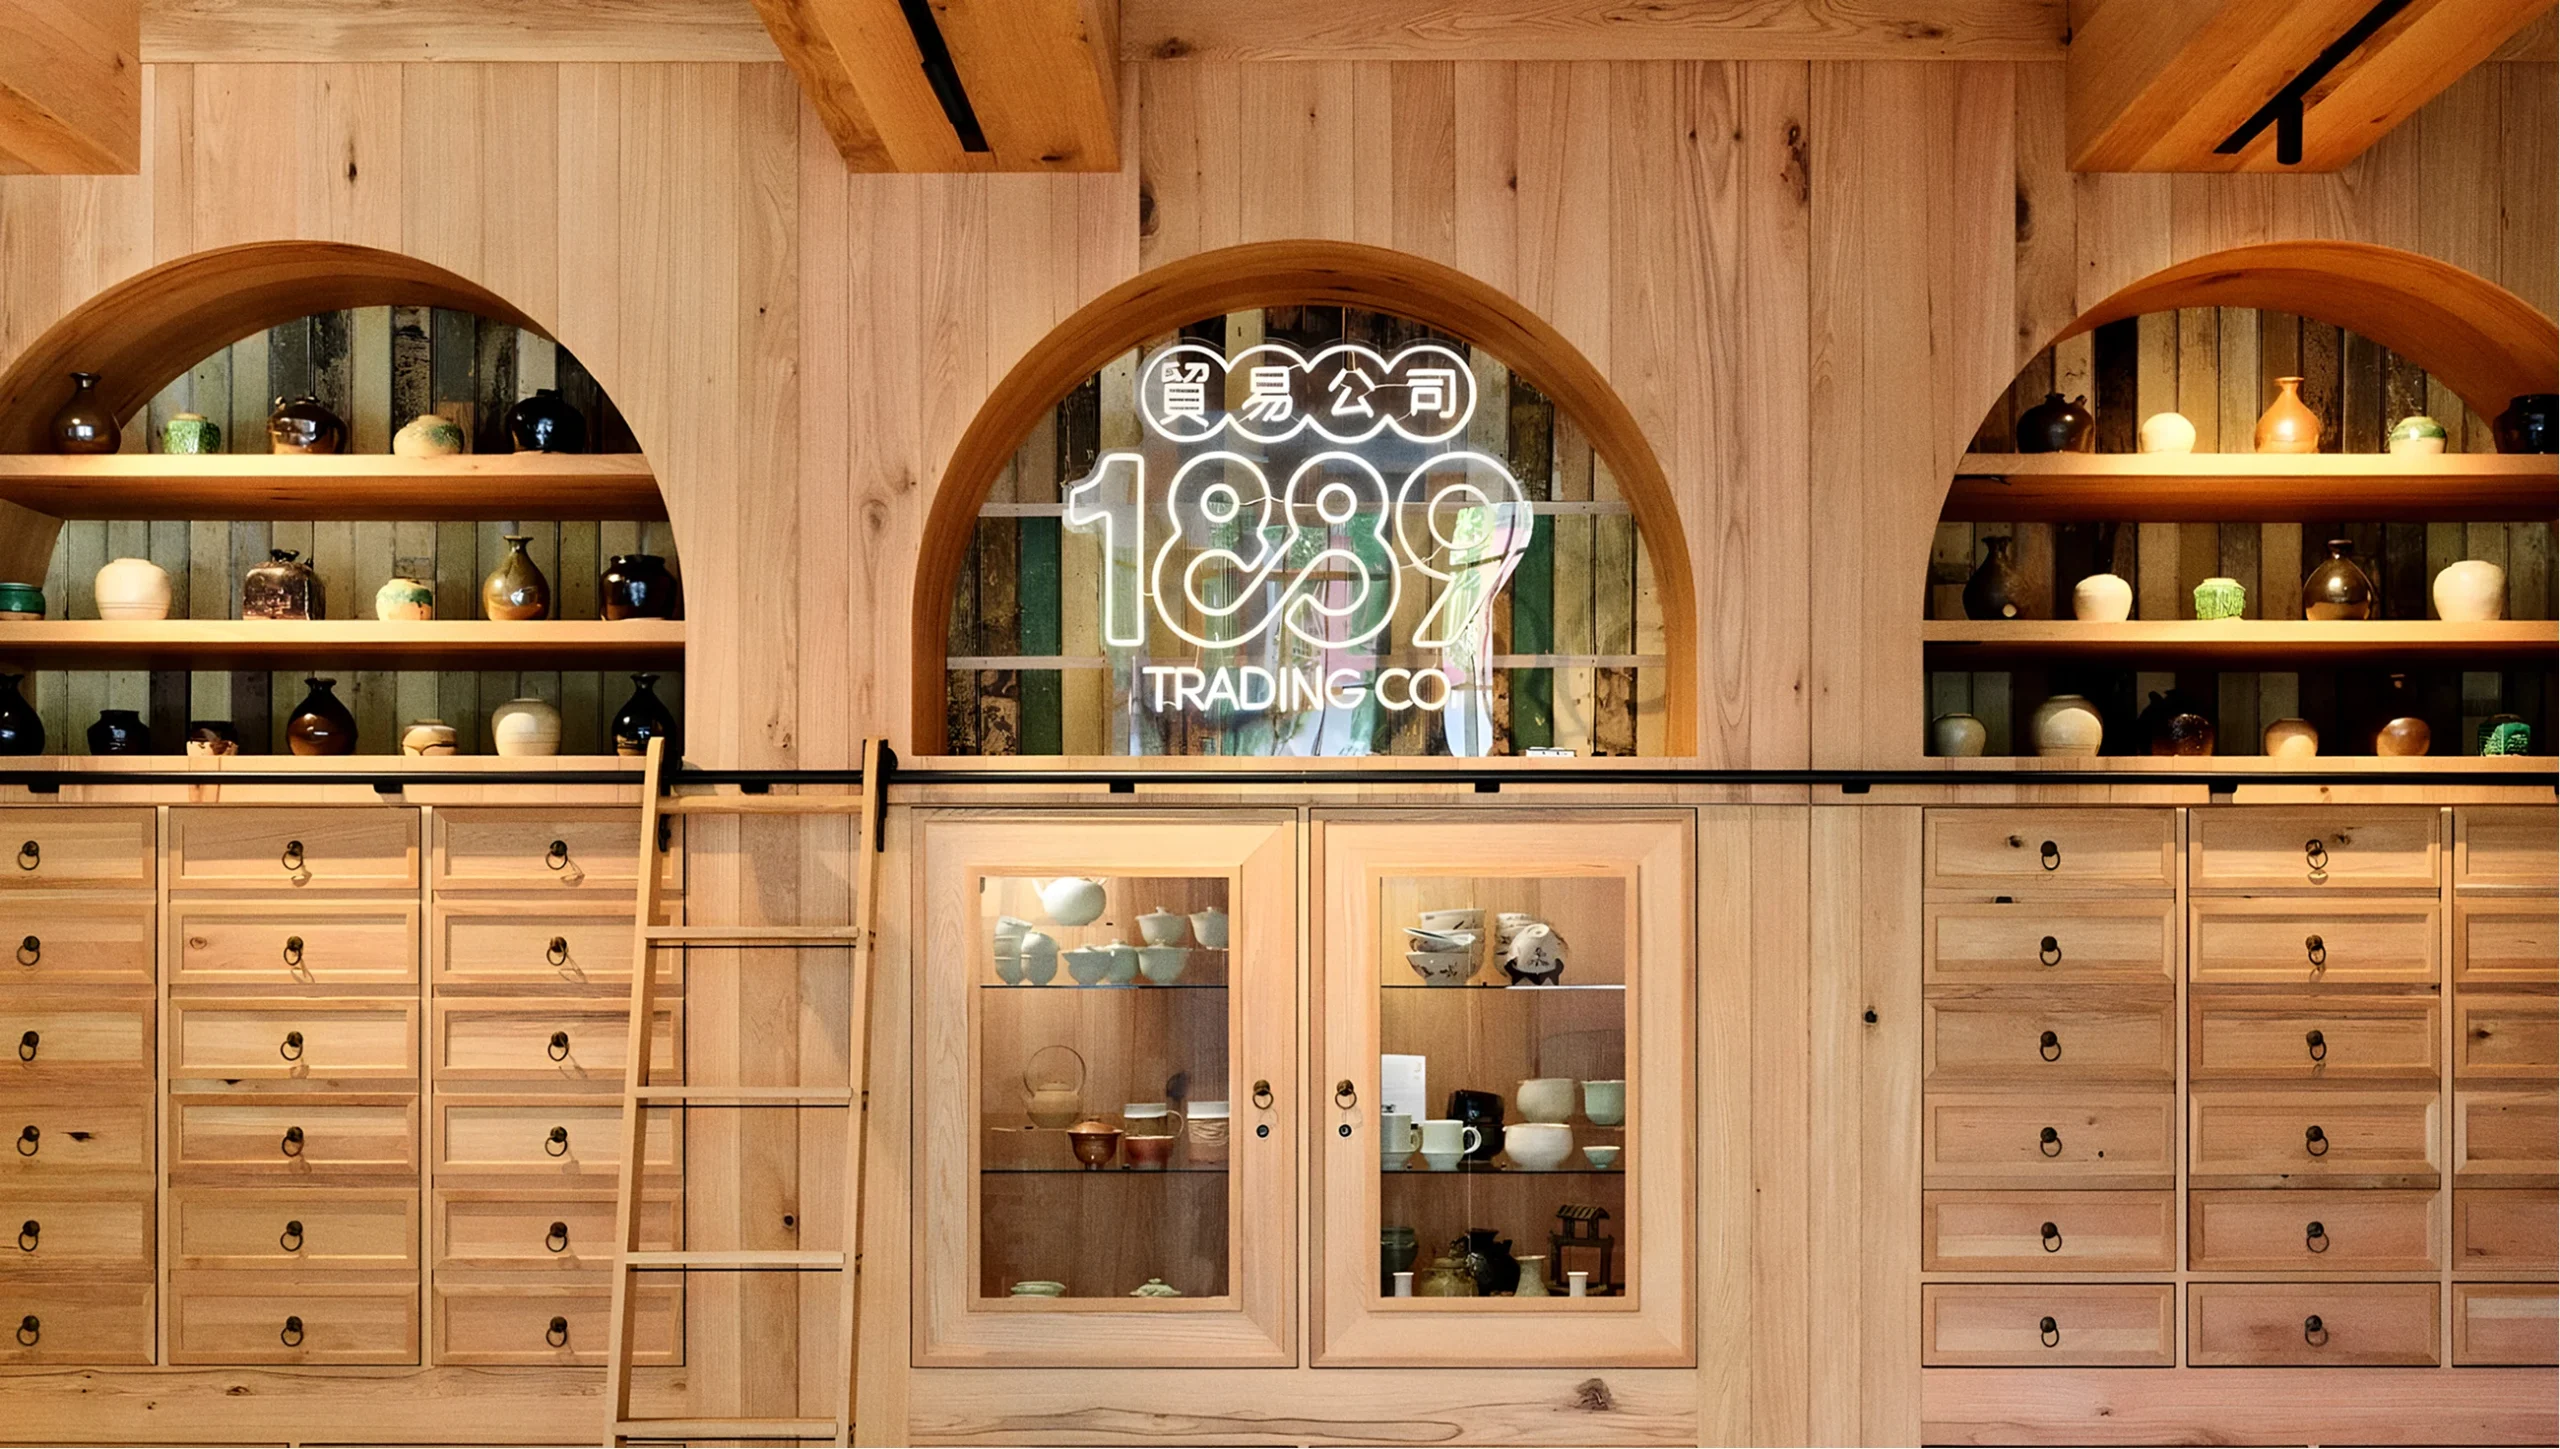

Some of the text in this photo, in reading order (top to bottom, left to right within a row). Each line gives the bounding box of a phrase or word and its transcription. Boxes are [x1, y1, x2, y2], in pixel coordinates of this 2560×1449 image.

[1160, 361, 1457, 426] 貿易公司
[1070, 450, 1528, 648] 1889
[1142, 665, 1367, 713] TRADING
